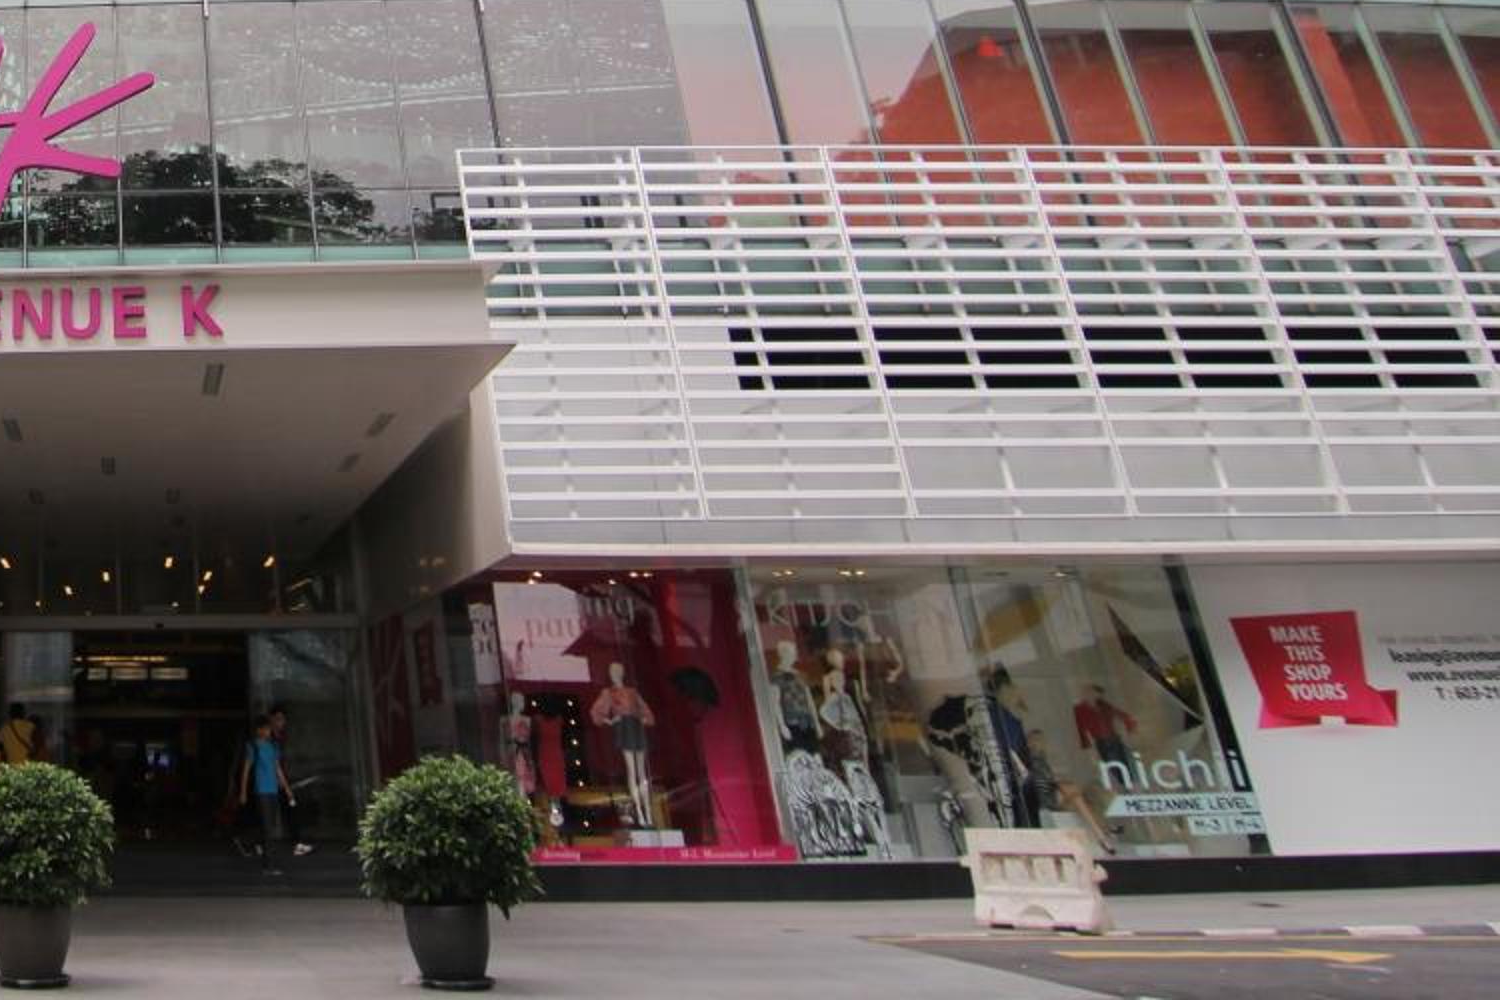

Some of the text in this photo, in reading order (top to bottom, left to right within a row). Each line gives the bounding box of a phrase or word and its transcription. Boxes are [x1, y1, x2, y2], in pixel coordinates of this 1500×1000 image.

[181, 283, 224, 338] K
[1268, 626, 1324, 643] MAKE
[1283, 645, 1326, 662] THIS
[1283, 665, 1332, 682] SHOP
[1284, 683, 1348, 701] YOURS
[1099, 750, 1247, 790] nichii
[1210, 796, 1253, 810] LEVEL
